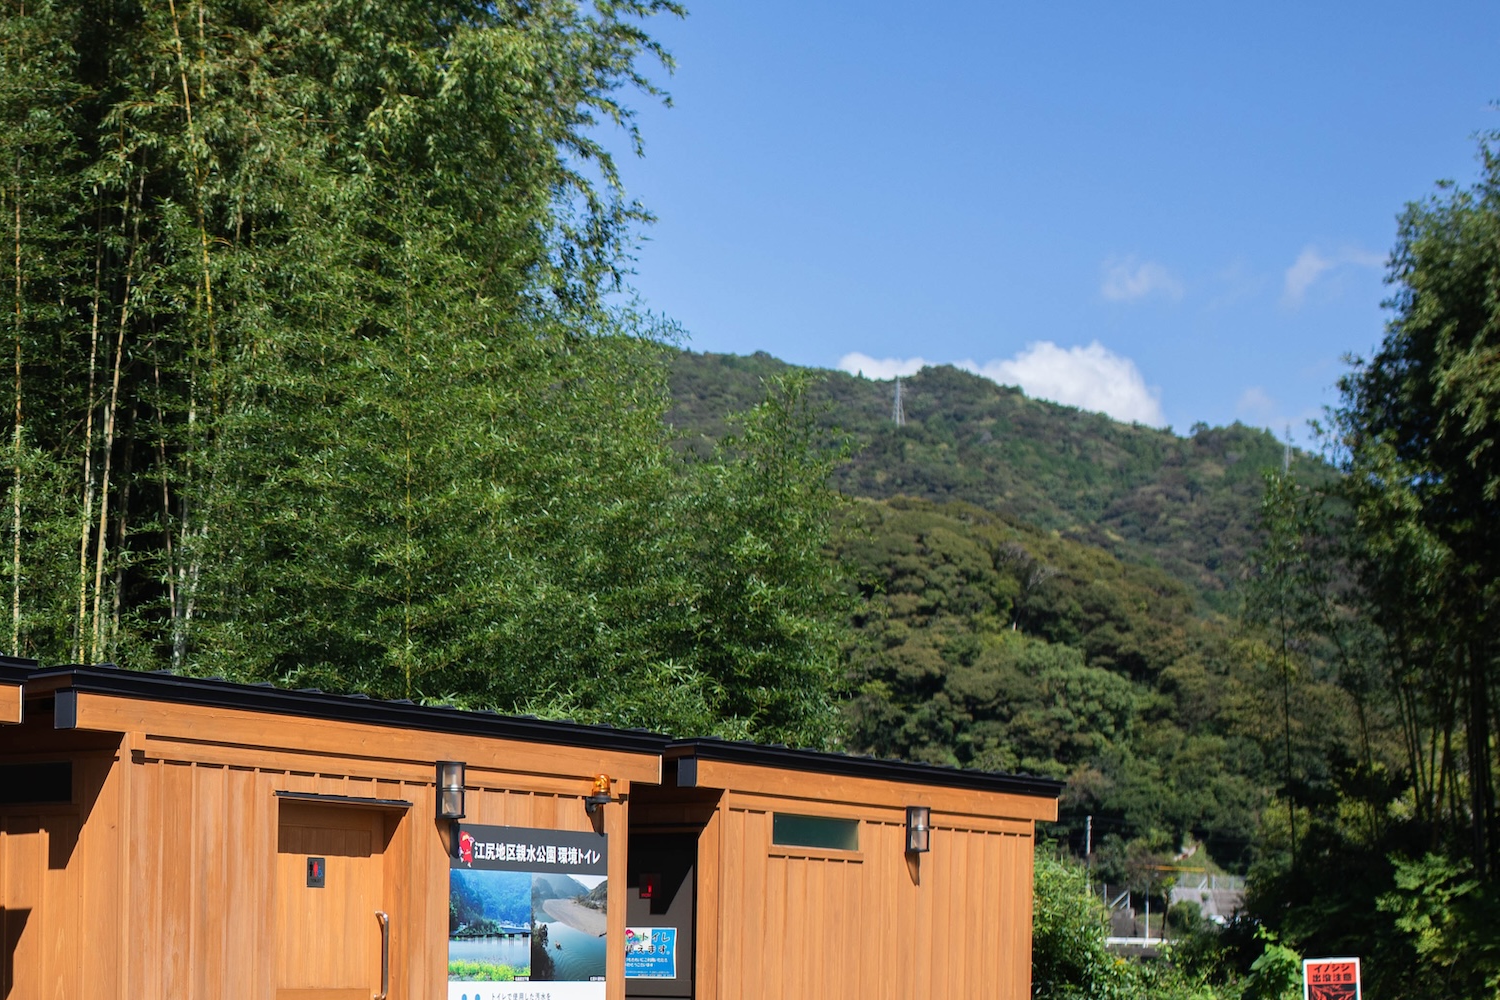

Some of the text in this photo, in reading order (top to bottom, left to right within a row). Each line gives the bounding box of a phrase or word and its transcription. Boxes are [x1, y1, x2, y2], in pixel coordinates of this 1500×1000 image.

[474, 841, 601, 865] 江尻地区親水公園 環境トイレ
[642, 932, 670, 942] トイレ
[1314, 964, 1350, 973] イノシシ
